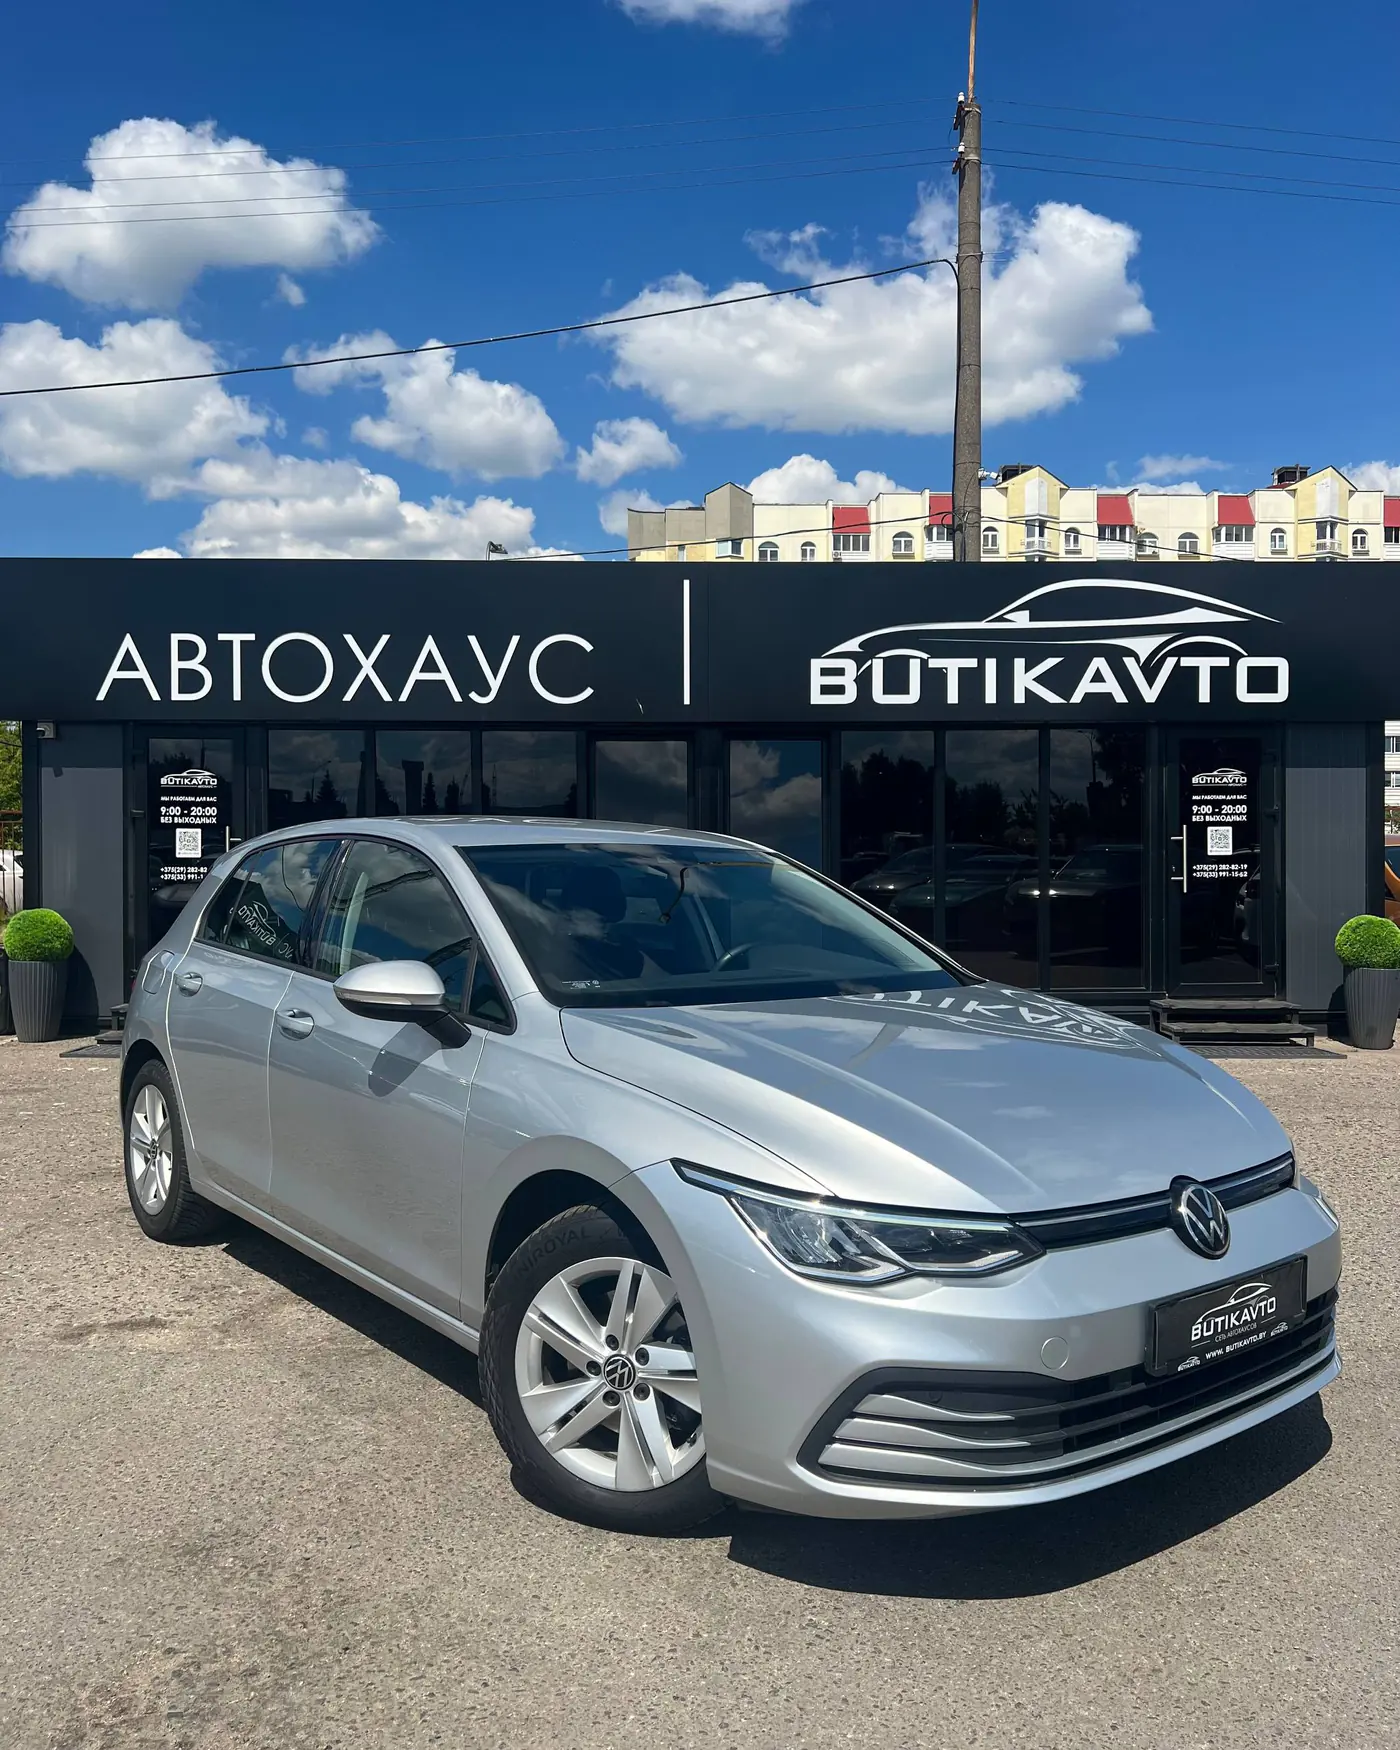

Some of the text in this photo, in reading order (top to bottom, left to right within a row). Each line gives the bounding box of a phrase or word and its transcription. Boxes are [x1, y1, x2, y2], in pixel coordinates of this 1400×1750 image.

[96, 631, 595, 705] АВТОХАУС
[810, 656, 1290, 705] BUTIKAVTO
[160, 777, 218, 785] BUTIKAVTO
[1192, 776, 1248, 784] BUTIKAVTO
[160, 806, 181, 816] 9:00
[190, 806, 218, 816] 20:00
[1192, 805, 1213, 814] 9:00
[1221, 805, 1247, 814] 20:00
[160, 816, 217, 825] БЕЗ ВЫХОДНЫХ
[514, 1226, 592, 1281] NIROYAL
[1191, 1296, 1276, 1341] BUTIKAVTO
